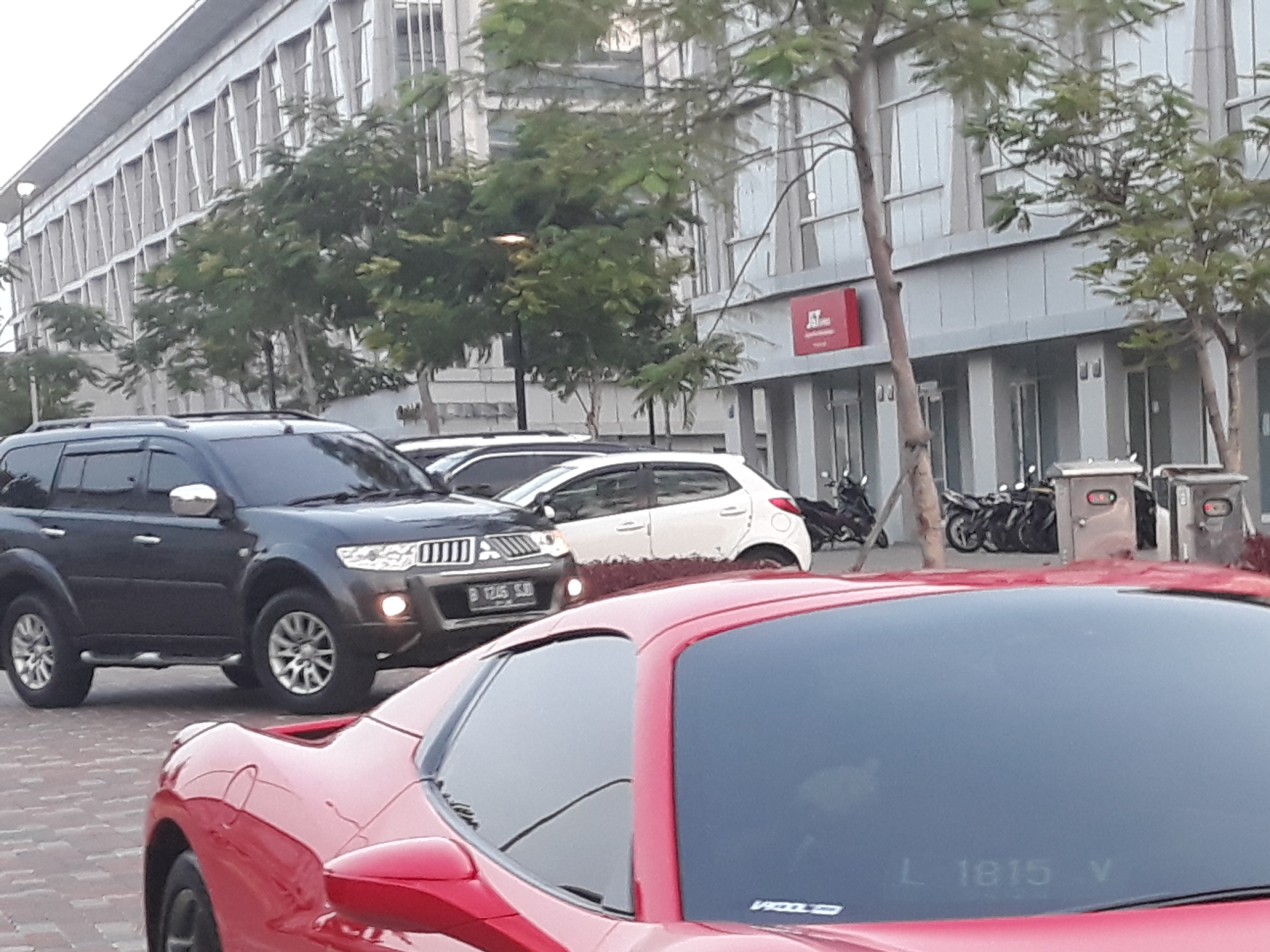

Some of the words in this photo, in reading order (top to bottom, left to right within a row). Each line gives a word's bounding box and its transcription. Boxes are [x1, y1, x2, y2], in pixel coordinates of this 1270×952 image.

[902, 857, 925, 886] L
[957, 857, 1050, 887] 1815
[1089, 857, 1111, 882] V
